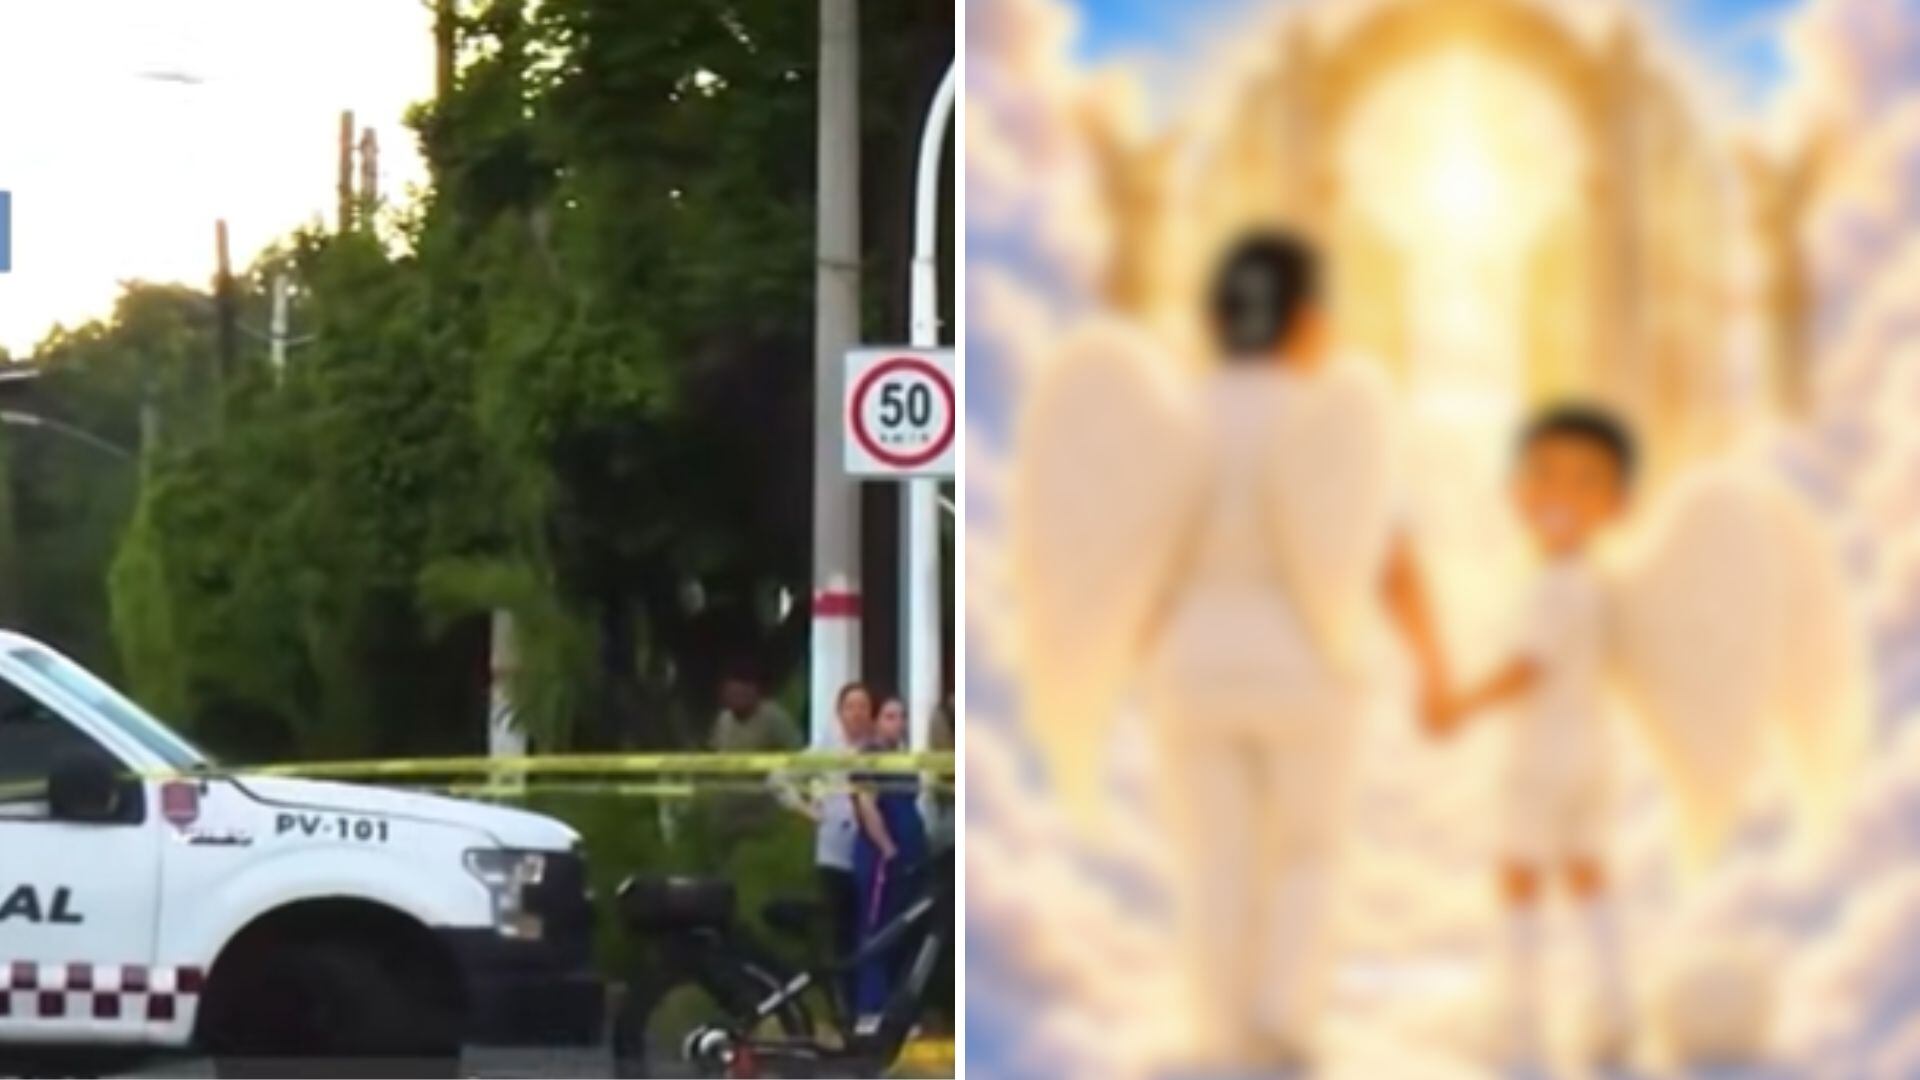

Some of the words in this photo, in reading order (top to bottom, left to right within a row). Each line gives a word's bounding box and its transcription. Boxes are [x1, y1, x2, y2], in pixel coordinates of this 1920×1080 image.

[879, 382, 932, 428] 50
[274, 812, 389, 843] PV-101
[0, 883, 84, 924] AL
